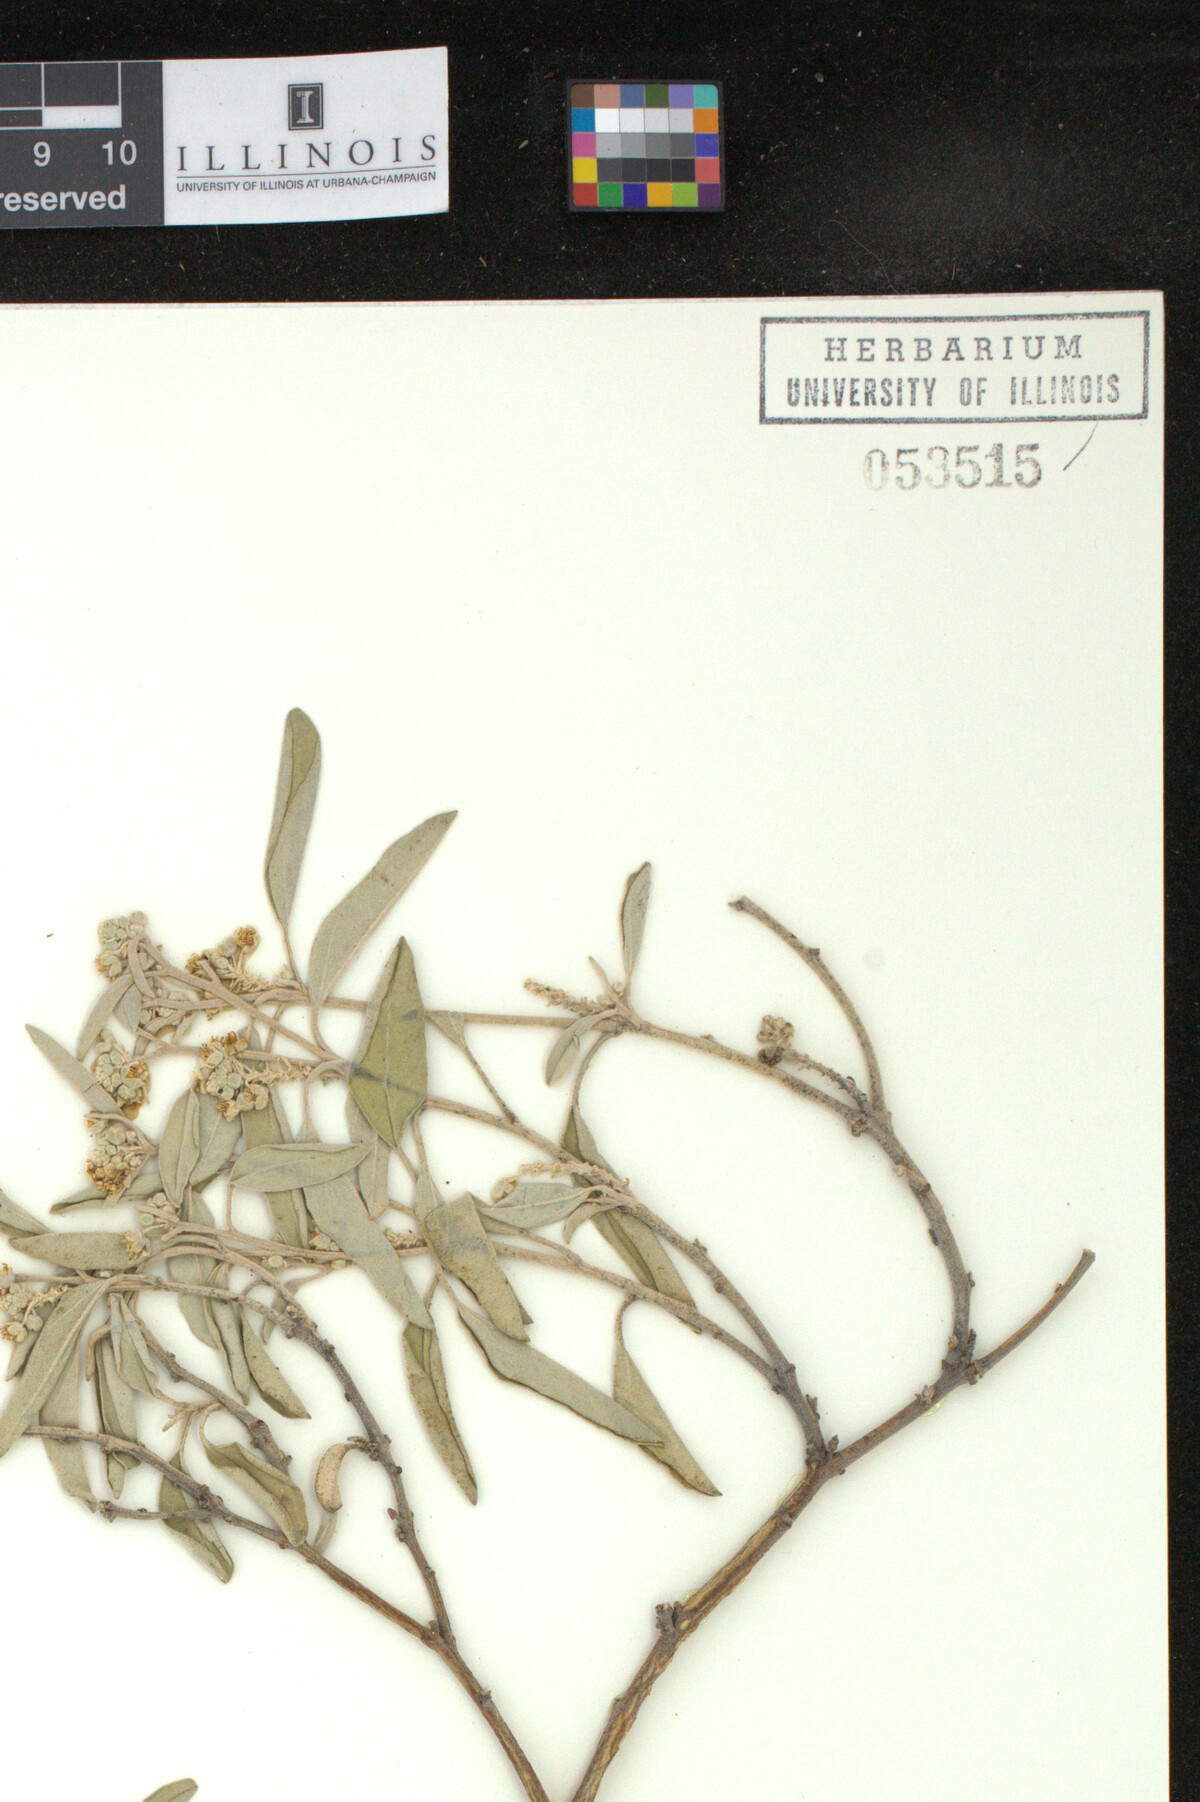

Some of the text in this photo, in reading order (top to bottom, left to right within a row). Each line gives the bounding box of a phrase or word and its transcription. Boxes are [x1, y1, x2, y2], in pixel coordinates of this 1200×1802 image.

[33, 141, 51, 167] 9
[102, 140, 137, 166] 10
[177, 135, 436, 172] ILLINOIS
[176, 171, 436, 192] UNIVERSITY OF ILLINOIS AT URBANA-CHAMPAIGN
[824, 334, 1084, 363] HERBARIUM
[786, 374, 1121, 407] UNIVERSITY OF ILLINOIS
[862, 443, 1043, 491] 053515
